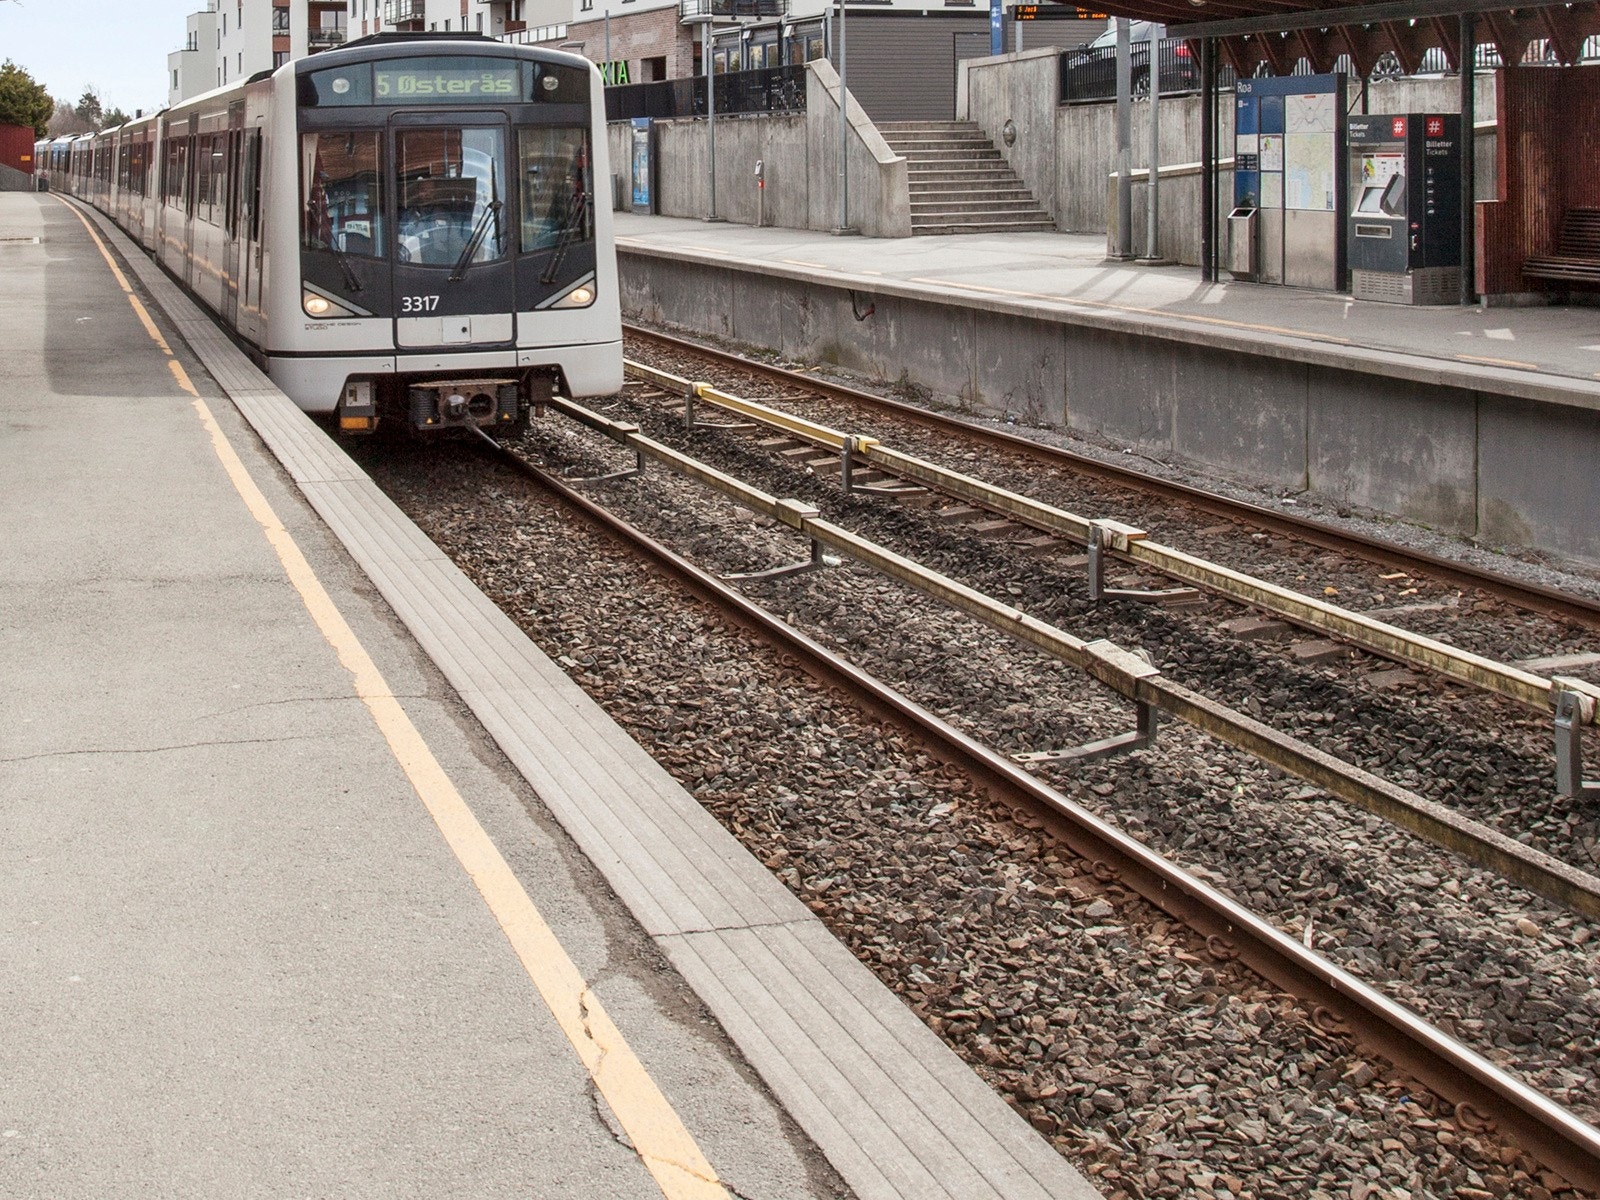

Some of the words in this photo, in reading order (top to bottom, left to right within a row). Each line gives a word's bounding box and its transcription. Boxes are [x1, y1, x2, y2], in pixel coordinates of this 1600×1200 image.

[377, 75, 390, 95] 5
[398, 73, 513, 94] Østerås
[1349, 123, 1369, 131] Billetter
[1425, 148, 1448, 156] Tickets
[401, 295, 440, 312] 3317
